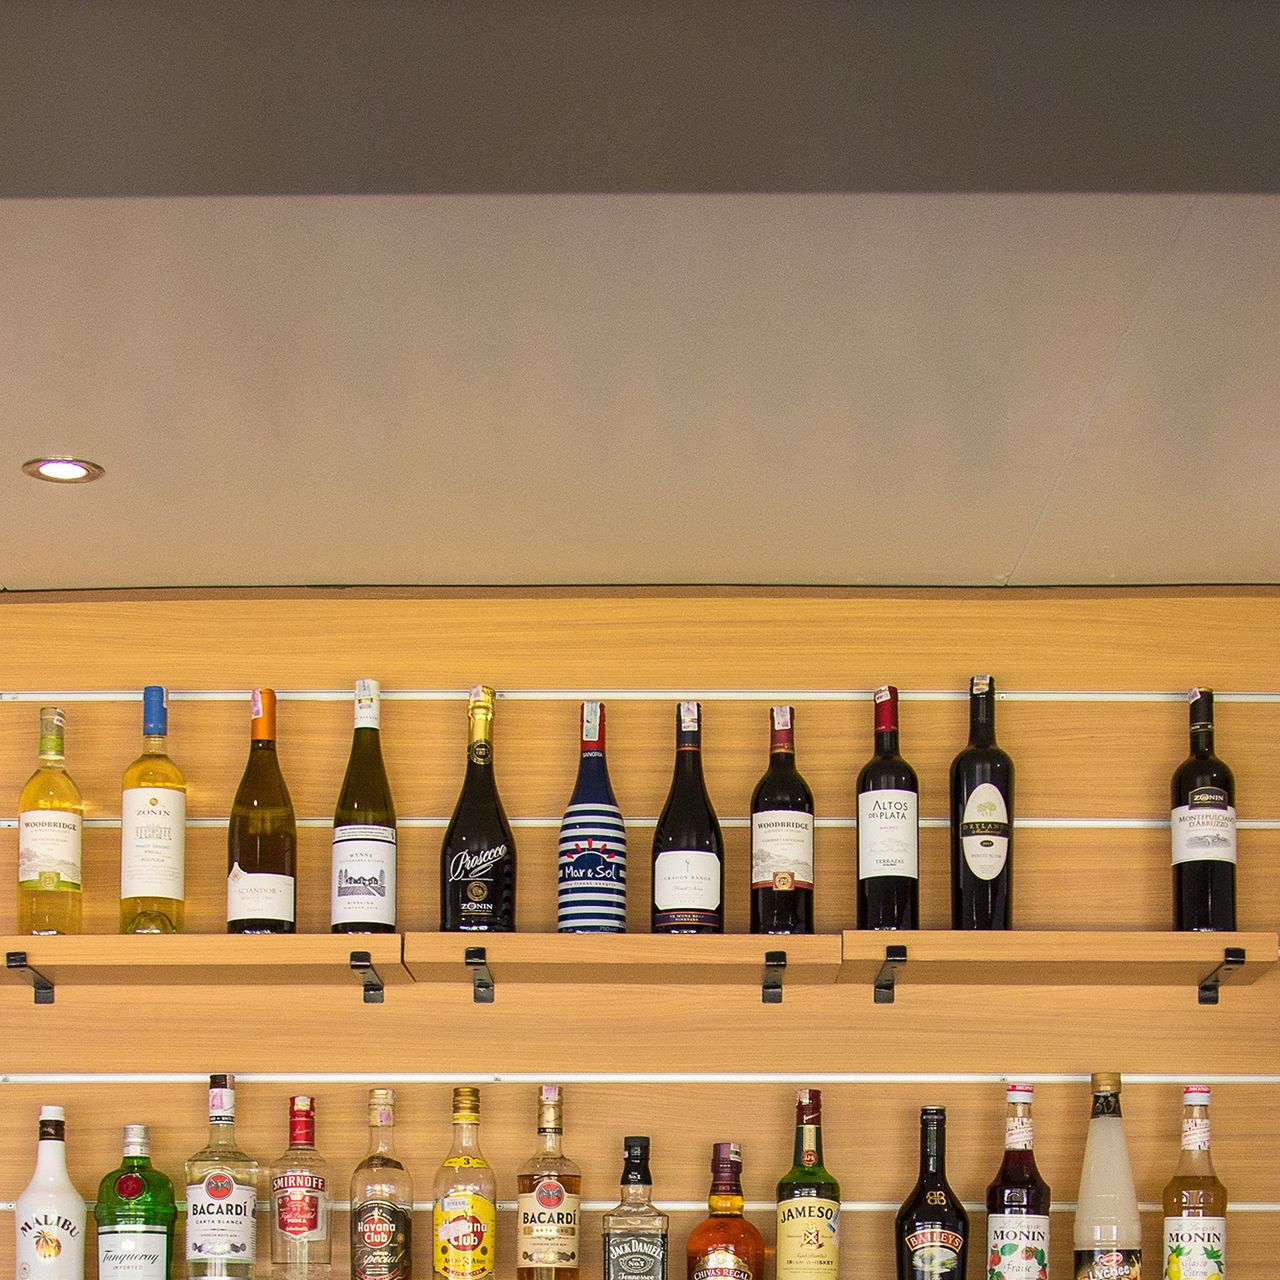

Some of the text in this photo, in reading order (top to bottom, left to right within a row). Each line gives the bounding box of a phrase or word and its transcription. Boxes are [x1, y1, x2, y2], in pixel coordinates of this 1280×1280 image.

[1193, 793, 1224, 801] ZONIN
[872, 800, 909, 811] ALTOS
[880, 812, 907, 820] PLATA
[24, 821, 77, 831] WOODBRIDGE
[758, 821, 810, 831] WOODBRIDGE
[449, 844, 507, 882] Prosecco
[565, 867, 586, 878] Mar
[594, 864, 616, 880] Sol
[461, 902, 493, 910] ZONIN
[273, 1176, 324, 1191] SMIRNOFF
[192, 1201, 248, 1216] BACARDÍ
[781, 1205, 834, 1224] JAMESO
[523, 1209, 577, 1225] BACARDÍ
[21, 1214, 80, 1238] MALIBU
[358, 1222, 395, 1232] Havana
[364, 1232, 388, 1242] Club
[450, 1233, 478, 1246] Club
[910, 1231, 960, 1247] BAILEYS
[993, 1230, 1045, 1241] MONIN
[1169, 1232, 1221, 1243] MONIN
[610, 1242, 631, 1259] JACK
[103, 1250, 160, 1264] Tanqueray
[618, 1272, 655, 1280] Tennessee
[694, 1268, 749, 1280] CHIVAS REGAL
